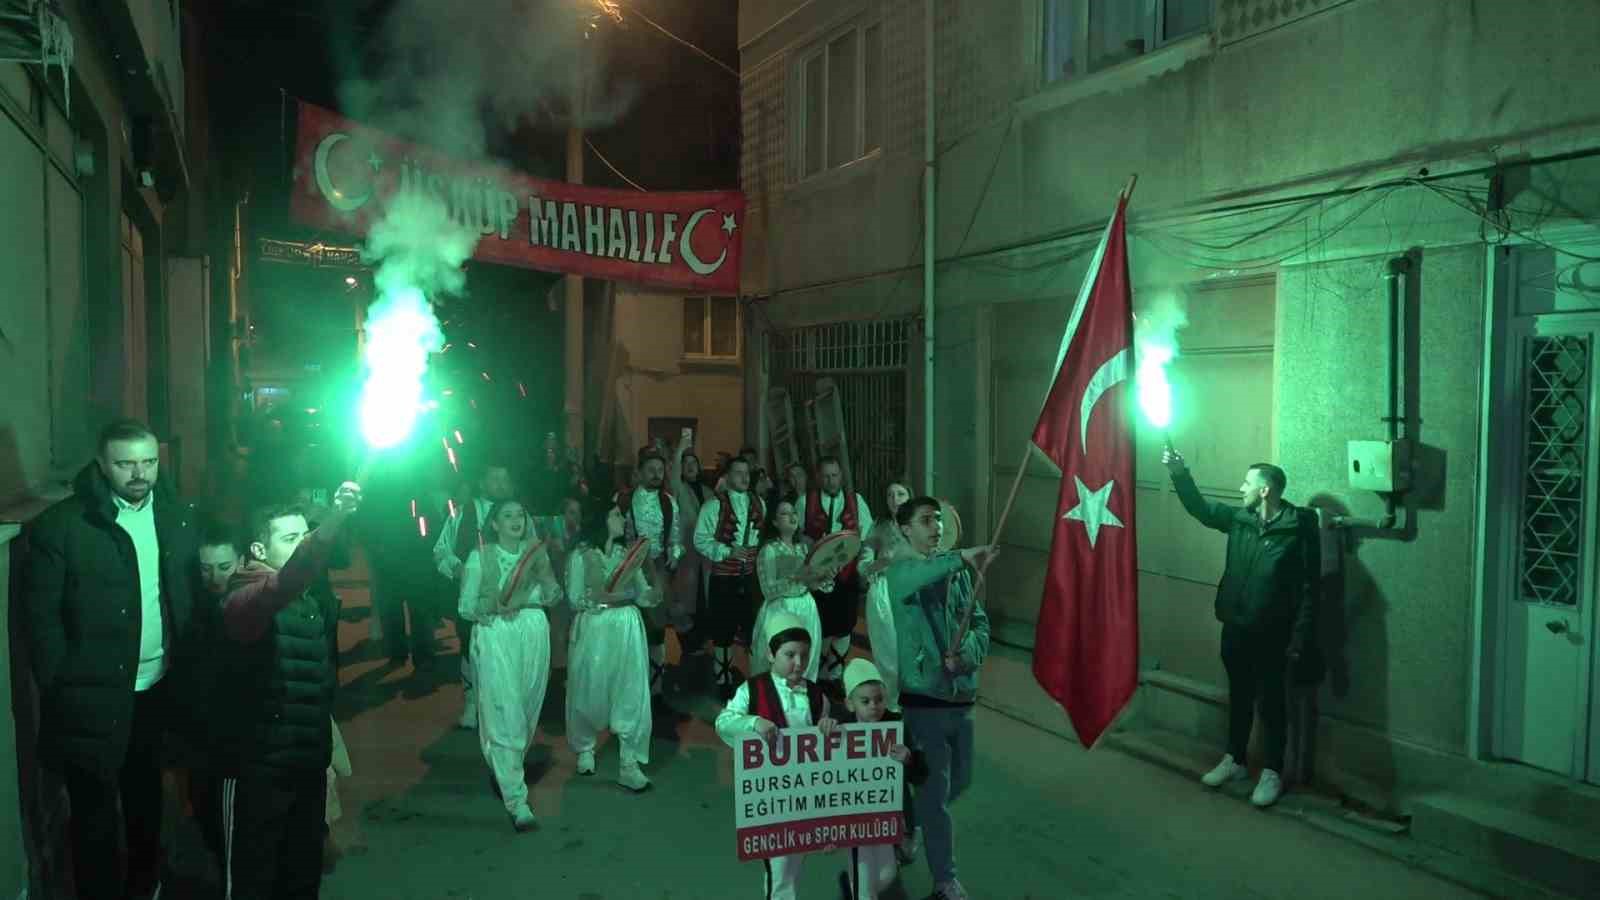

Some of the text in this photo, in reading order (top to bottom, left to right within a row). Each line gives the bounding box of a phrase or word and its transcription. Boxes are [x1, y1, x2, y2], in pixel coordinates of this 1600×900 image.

[529, 195, 678, 264] MAHALLE
[743, 728, 897, 770] BURFEM
[743, 766, 896, 794] BURSA FOLKLOR
[745, 788, 895, 818] EĞİTİM MERKEZİ
[800, 832, 811, 845] ve
[815, 824, 849, 844] SPOR
[850, 816, 897, 839] KULÜBÜ
